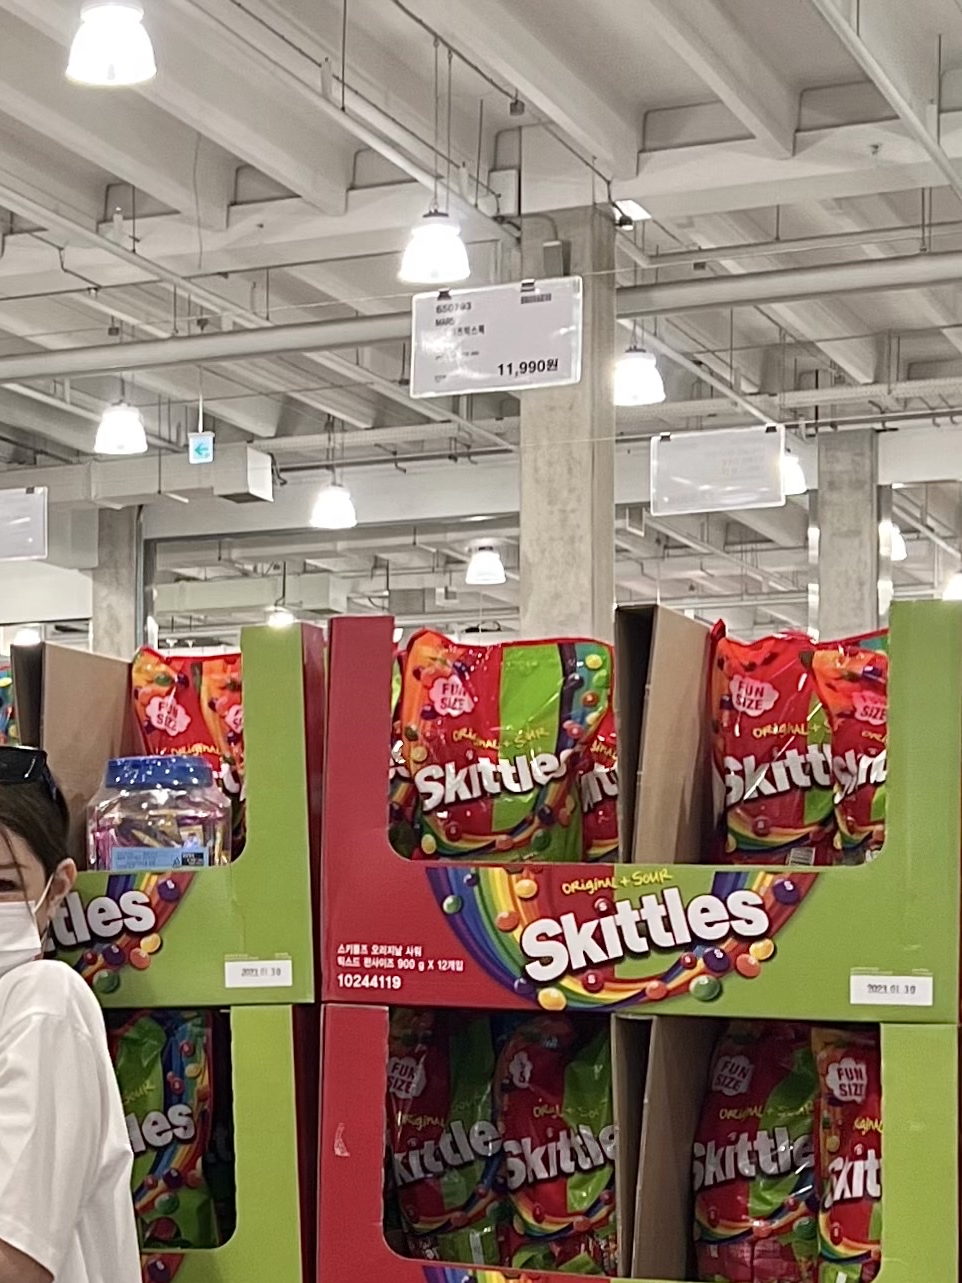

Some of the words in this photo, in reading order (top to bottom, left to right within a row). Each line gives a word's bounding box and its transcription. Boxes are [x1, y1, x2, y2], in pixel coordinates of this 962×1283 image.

[498, 359, 558, 378] 11,990원
[736, 682, 766, 699] FUN
[522, 889, 770, 983] Skittles
[338, 944, 368, 955] 스키틀즈
[398, 959, 415, 969] 900
[338, 974, 401, 989] 10244119
[720, 1056, 749, 1078] FUN
[836, 1067, 864, 1081] FUN
